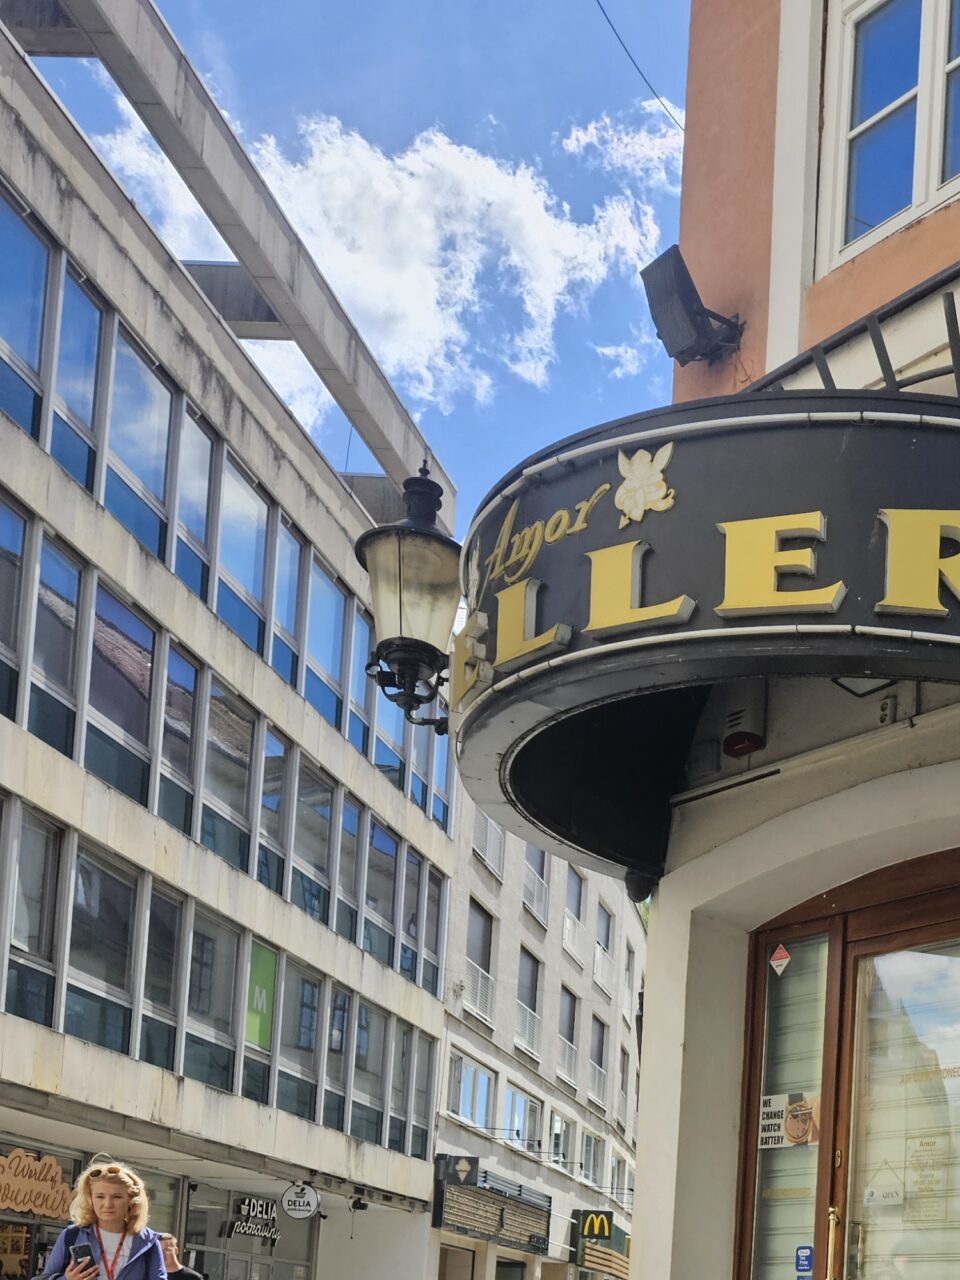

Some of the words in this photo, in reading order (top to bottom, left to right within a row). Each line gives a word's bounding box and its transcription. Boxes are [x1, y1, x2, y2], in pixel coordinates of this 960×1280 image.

[485, 483, 611, 585] Amor
[762, 1098, 772, 1108] WE
[761, 1109, 784, 1120] CHANGE
[761, 1122, 781, 1133] WATCH
[760, 1135, 784, 1146] BATTERY
[9, 1155, 52, 1183] World
[0, 1182, 72, 1215] ouvenir
[287, 1199, 312, 1208] DELIA
[250, 1198, 278, 1220] DELIA
[231, 1217, 281, 1247] potraviny
